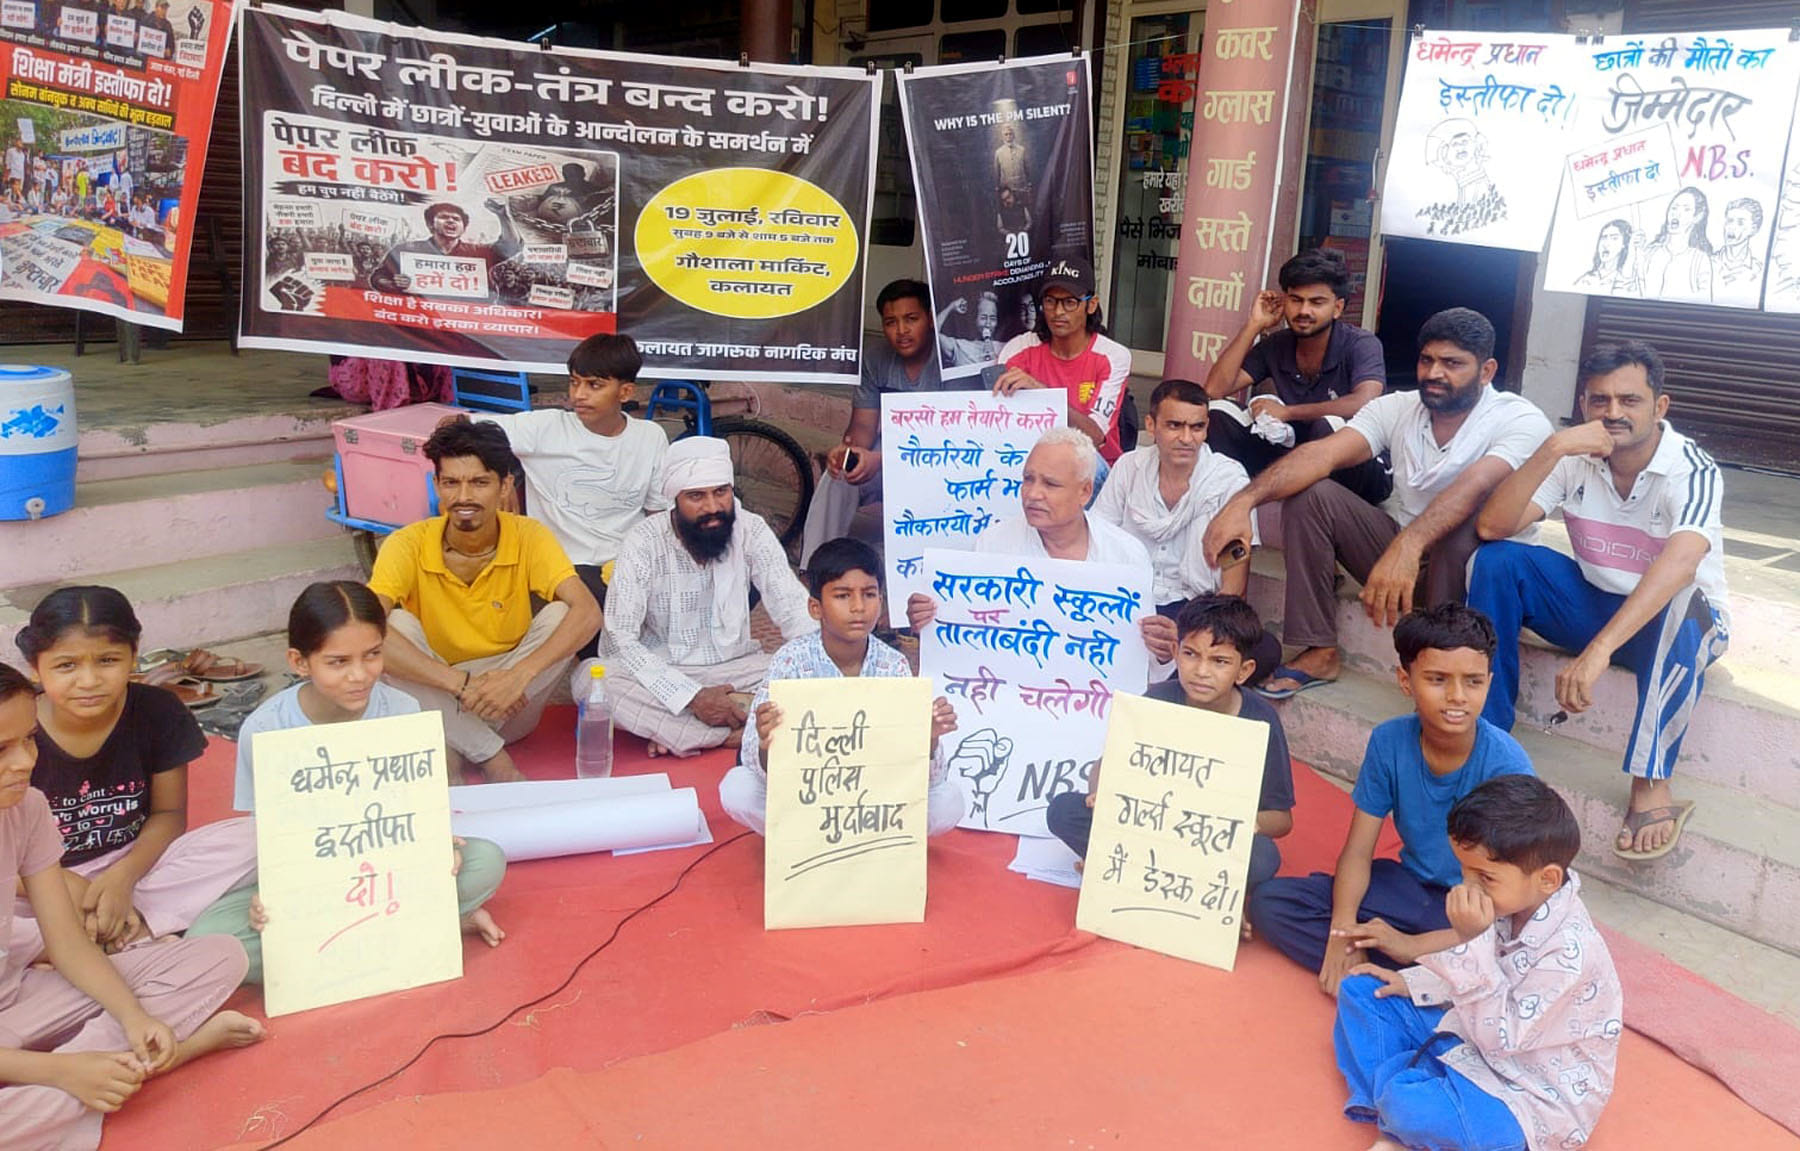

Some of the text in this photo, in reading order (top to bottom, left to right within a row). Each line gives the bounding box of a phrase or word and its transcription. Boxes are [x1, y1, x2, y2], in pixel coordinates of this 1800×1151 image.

[1216, 27, 1278, 61] कवर
[1482, 43, 1548, 66] प्रधान
[1593, 37, 1776, 74] छात्रों की मौतों का
[11, 81, 37, 100] सोनम
[12, 48, 56, 82] शिक्षा
[58, 58, 91, 93] मंत्री
[94, 70, 146, 102] इस्तीफा
[148, 77, 172, 107] दो!
[282, 29, 387, 80] पेपर
[621, 81, 716, 116] बन्द
[724, 85, 828, 122] करो!
[1204, 90, 1276, 125] ग्लास
[1439, 74, 1536, 116] इस्तीफा
[311, 85, 377, 116] दिल्ली
[380, 97, 408, 120] में
[546, 114, 570, 136] के
[575, 120, 679, 145] आन्दोलन
[681, 124, 704, 147] के
[707, 131, 788, 153] समर्थन
[790, 133, 814, 154] में
[934, 104, 1071, 131] WHY IS THE PM SILENT?
[272, 117, 418, 157] पेपर लीक
[278, 144, 457, 191] बंद करो!
[490, 166, 554, 191] LEAKED
[1143, 166, 1164, 190] हमारे
[1206, 151, 1256, 191] गार्ड
[1585, 161, 1660, 202] इस्तीफा दो
[297, 184, 316, 196] हम
[318, 185, 337, 200] चुप
[340, 187, 365, 199] नहीं
[665, 206, 841, 228] 19 जुलाई, रविवार
[1119, 216, 1144, 240] पैसे
[1196, 211, 1253, 252] सस्ते
[672, 228, 834, 244] सुबह 9 बजे से शाम 5 बजे तक
[1006, 231, 1030, 259] 20
[414, 258, 450, 271] हमारा
[675, 252, 755, 272] गौशाला
[992, 270, 1045, 286] ACCOUNTABILITY
[1004, 256, 1032, 268] DAYS OF
[1051, 260, 1080, 278] KING
[415, 272, 479, 291] हमें दो!
[709, 279, 793, 297] कलायत
[1188, 271, 1245, 311] दामों
[363, 291, 402, 306] शिक्षा
[407, 295, 417, 309] है
[421, 301, 469, 313] सबका
[374, 309, 398, 321] बंद
[399, 313, 428, 325] करो
[433, 318, 478, 331] इसका
[763, 343, 828, 360] नागरिक
[830, 345, 857, 362] मंच
[1192, 330, 1228, 363] पर
[939, 409, 965, 434] हम
[966, 400, 1013, 435] तैयारी
[1017, 408, 1059, 434] करते
[897, 435, 1028, 470] नौकरियों के
[944, 468, 998, 502] फार्म
[933, 566, 1141, 624] सरकारी स्कूलों
[968, 609, 1010, 625] पर
[935, 618, 1060, 669] तालाबंदी
[1018, 678, 1114, 720] चलेगी
[791, 709, 870, 757] दिल्ली
[367, 748, 436, 790] प्रधान
[799, 755, 866, 805] पुलिस
[1129, 741, 1224, 788] कलायत
[63, 797, 76, 806] to
[78, 803, 122, 817] worry
[820, 790, 908, 844] मुर्दाबाद
[315, 802, 416, 858] इस्तीफा
[1173, 810, 1244, 855] स्कूल
[1103, 844, 1128, 884] में
[1143, 849, 1194, 903] डेस्क
